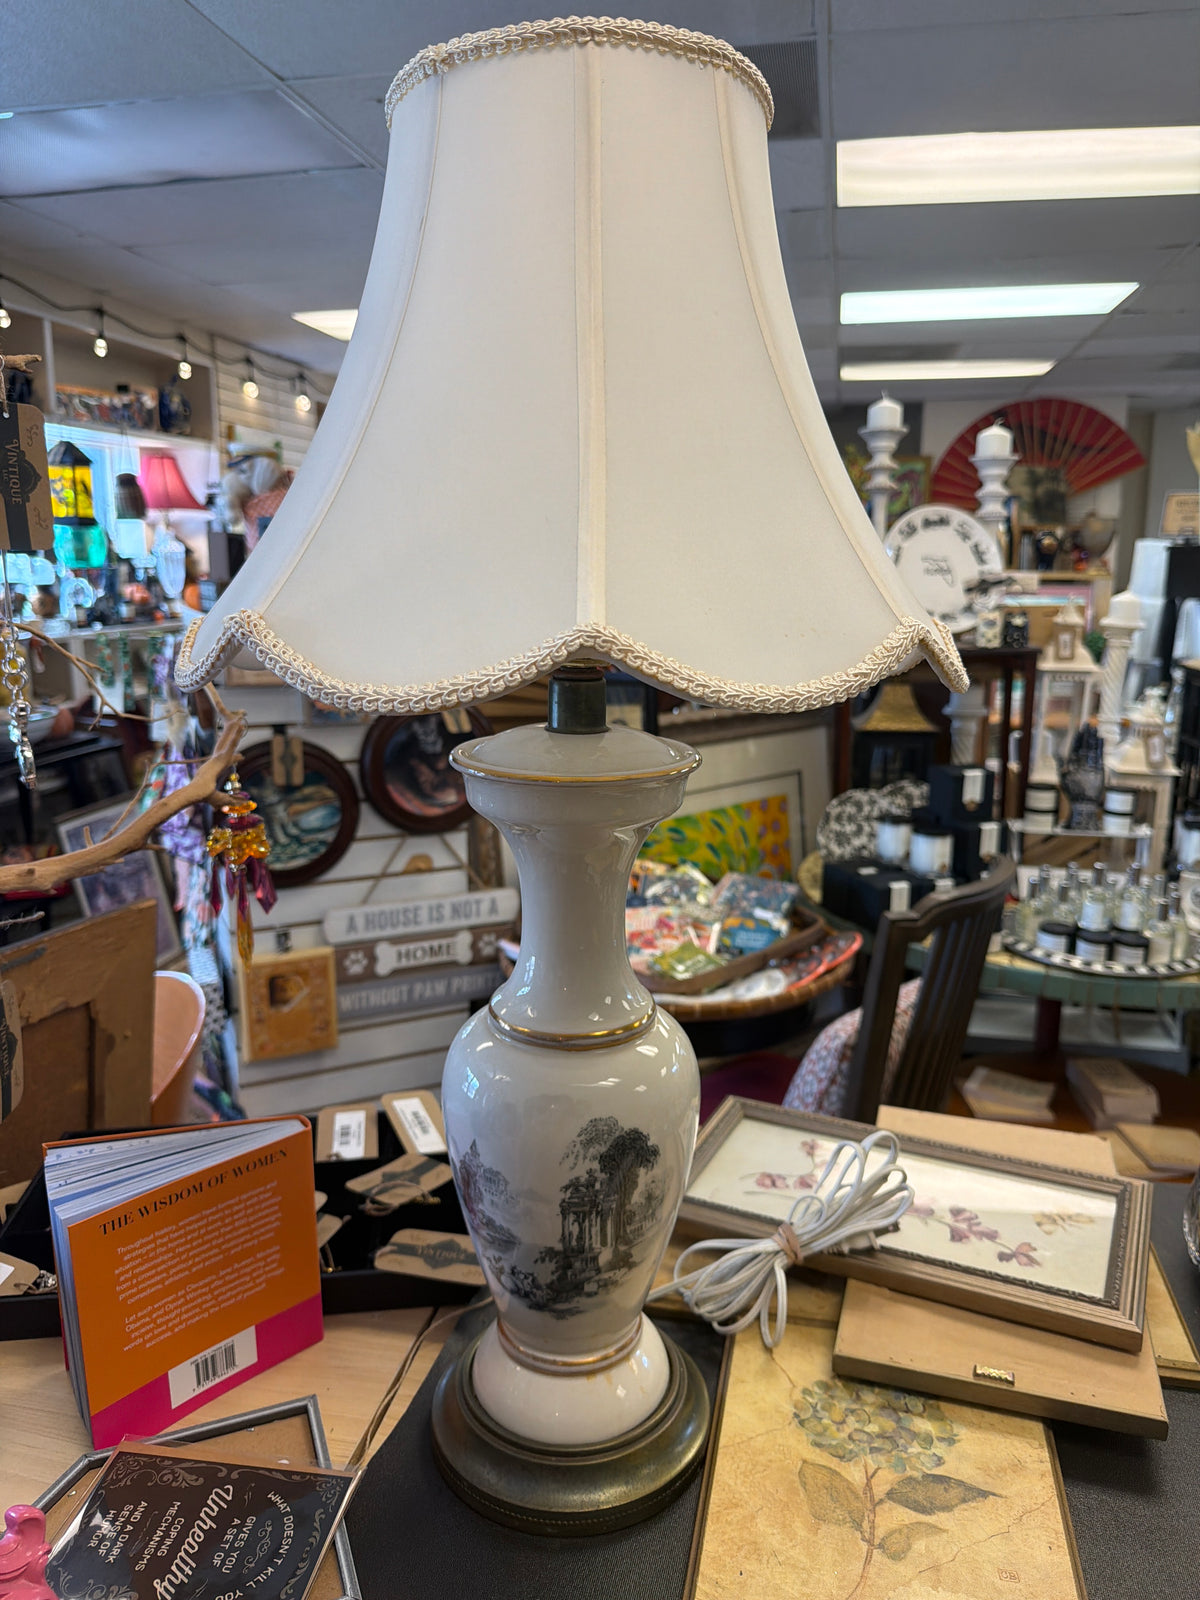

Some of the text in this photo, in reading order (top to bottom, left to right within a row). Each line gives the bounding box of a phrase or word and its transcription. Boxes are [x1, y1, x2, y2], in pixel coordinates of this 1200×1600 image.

[5, 438, 23, 505] VINTIQUE
[346, 897, 499, 934] A HOUSE IS NOT A
[396, 942, 457, 964] HOME
[340, 984, 410, 1011] WITHOUT
[413, 978, 449, 999] PAW
[99, 1211, 134, 1235] THE
[138, 1181, 203, 1219] WISDOM
[207, 1171, 228, 1189] OF
[232, 1148, 288, 1178] WOMEN
[267, 1491, 291, 1514] WHAT
[88, 1510, 117, 1548] HUMOR
[98, 1504, 134, 1557] SENSE OF
[105, 1500, 148, 1564] AND A DARK
[135, 1501, 181, 1571] MECHANISMS
[153, 1484, 234, 1600] Unhealthy
[157, 1517, 185, 1557] COPING
[212, 1518, 241, 1568] A SET OF
[222, 1516, 256, 1573] GIVES YOU
[273, 1515, 294, 1566] DOESN'T
[245, 1566, 275, 1588] KILL
